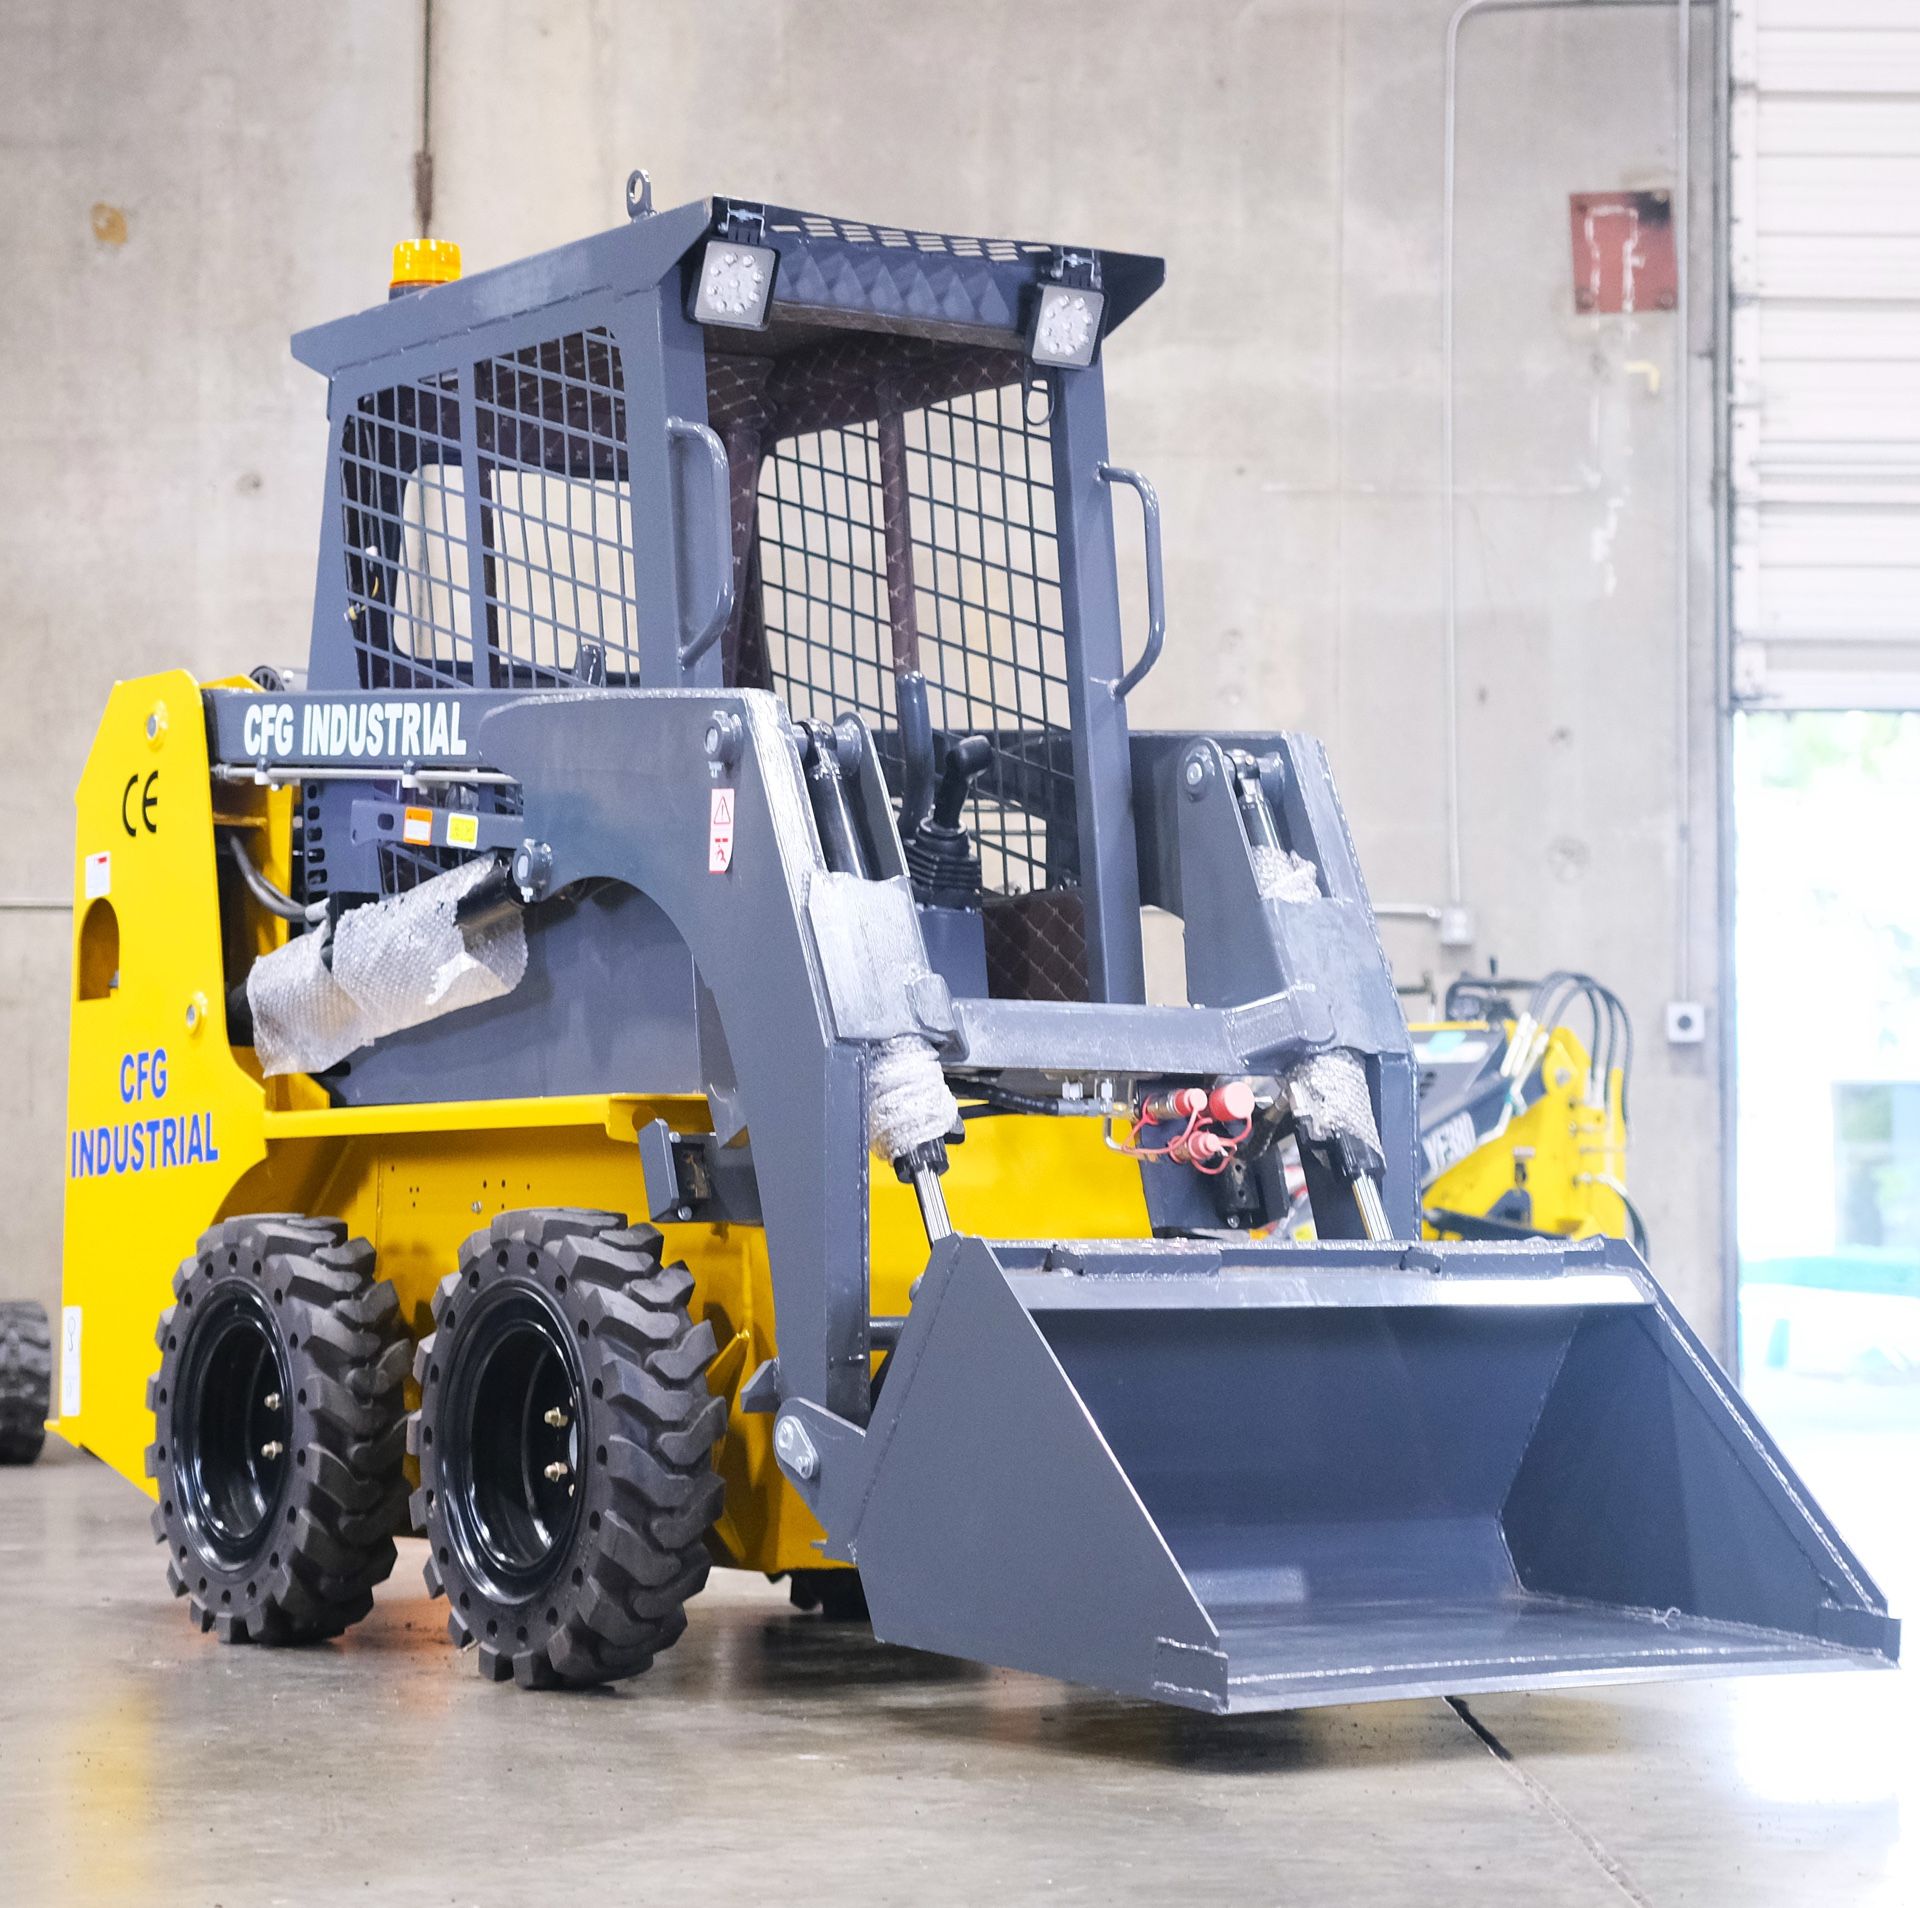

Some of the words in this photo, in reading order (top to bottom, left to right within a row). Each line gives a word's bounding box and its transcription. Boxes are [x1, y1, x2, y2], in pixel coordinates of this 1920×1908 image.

[244, 703, 294, 757] CFG
[302, 702, 467, 757] INDUSTRIAL
[122, 770, 159, 837] CE
[120, 1048, 167, 1103] CFG
[71, 1112, 218, 1178] INDUSTRIAL
